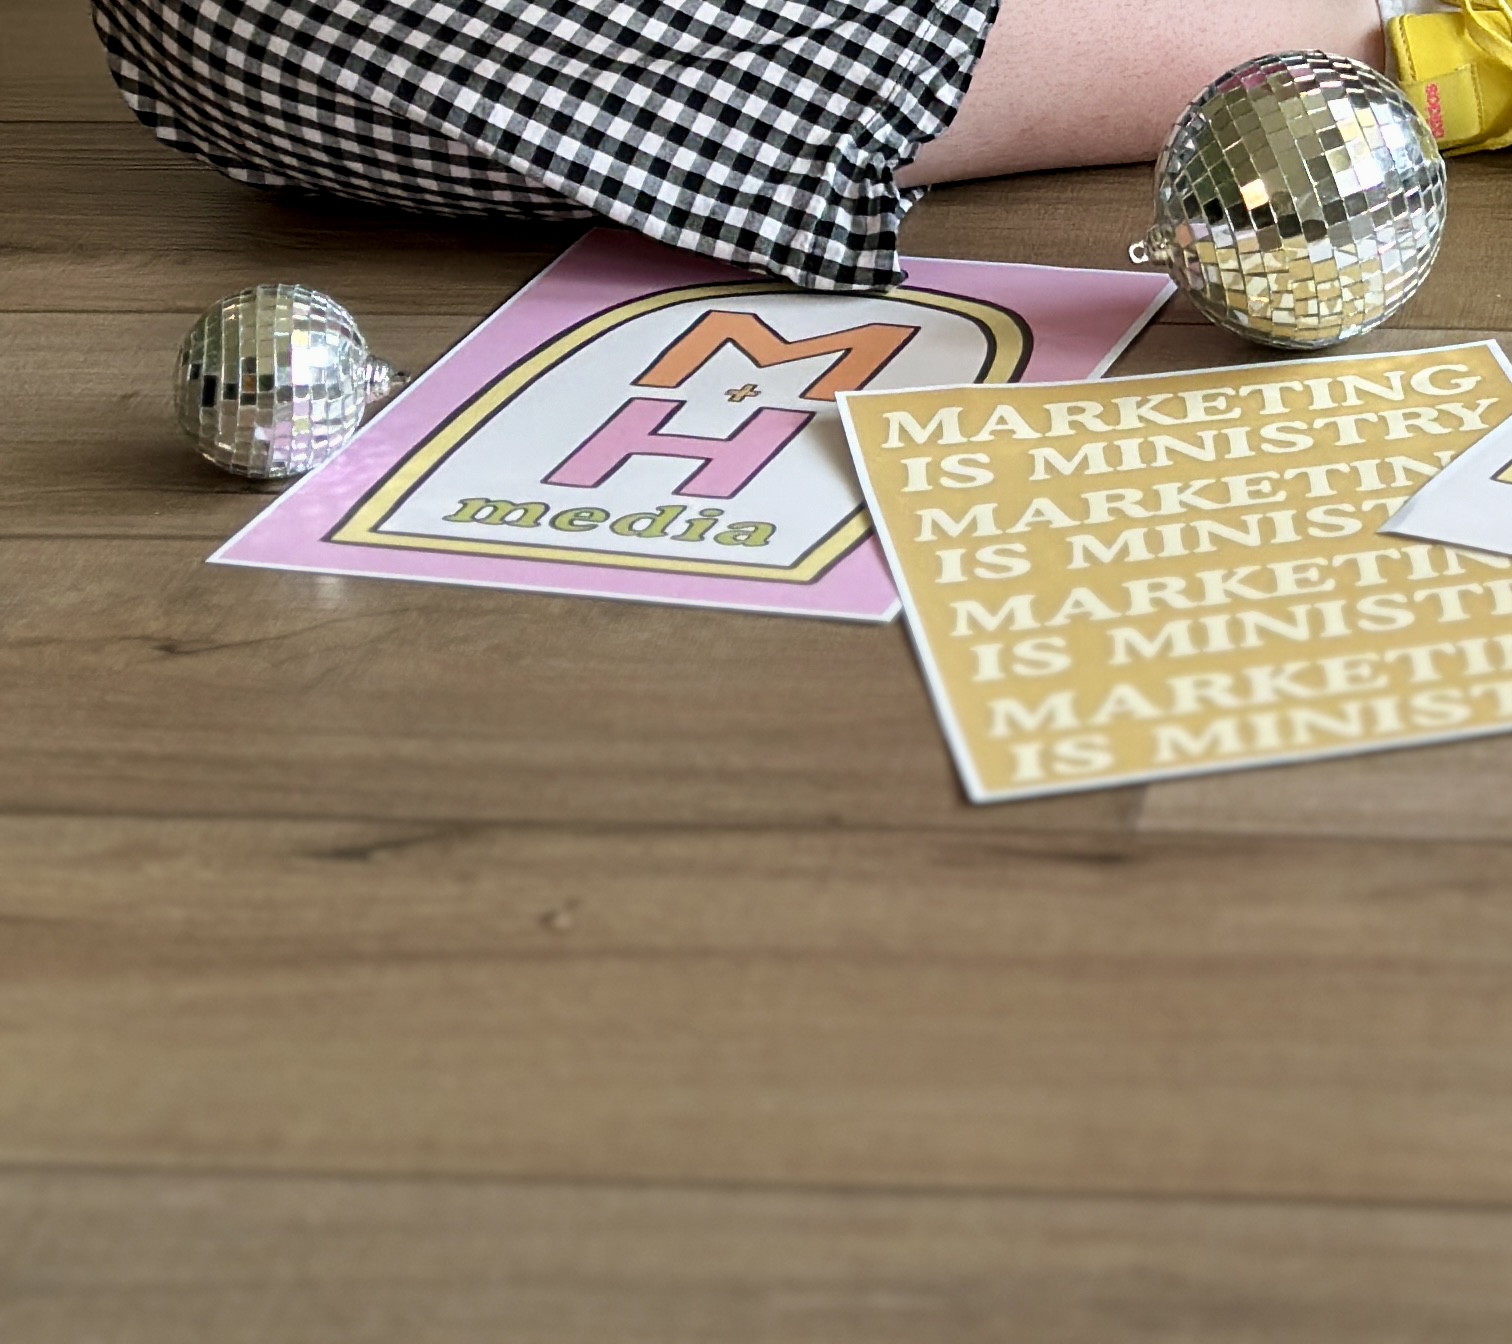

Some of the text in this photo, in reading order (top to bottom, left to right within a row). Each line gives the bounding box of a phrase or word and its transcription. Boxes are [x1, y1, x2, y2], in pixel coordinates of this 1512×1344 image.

[630, 308, 921, 402] M
[541, 396, 816, 500] H
[882, 363, 1484, 449] MARKETING
[901, 397, 1499, 493] IS MINISTRY
[442, 496, 778, 547] media
[914, 450, 1456, 543] MARKETIN
[935, 543, 1032, 584] IS
[973, 636, 1073, 682] IS
[1010, 733, 1116, 783] IS
